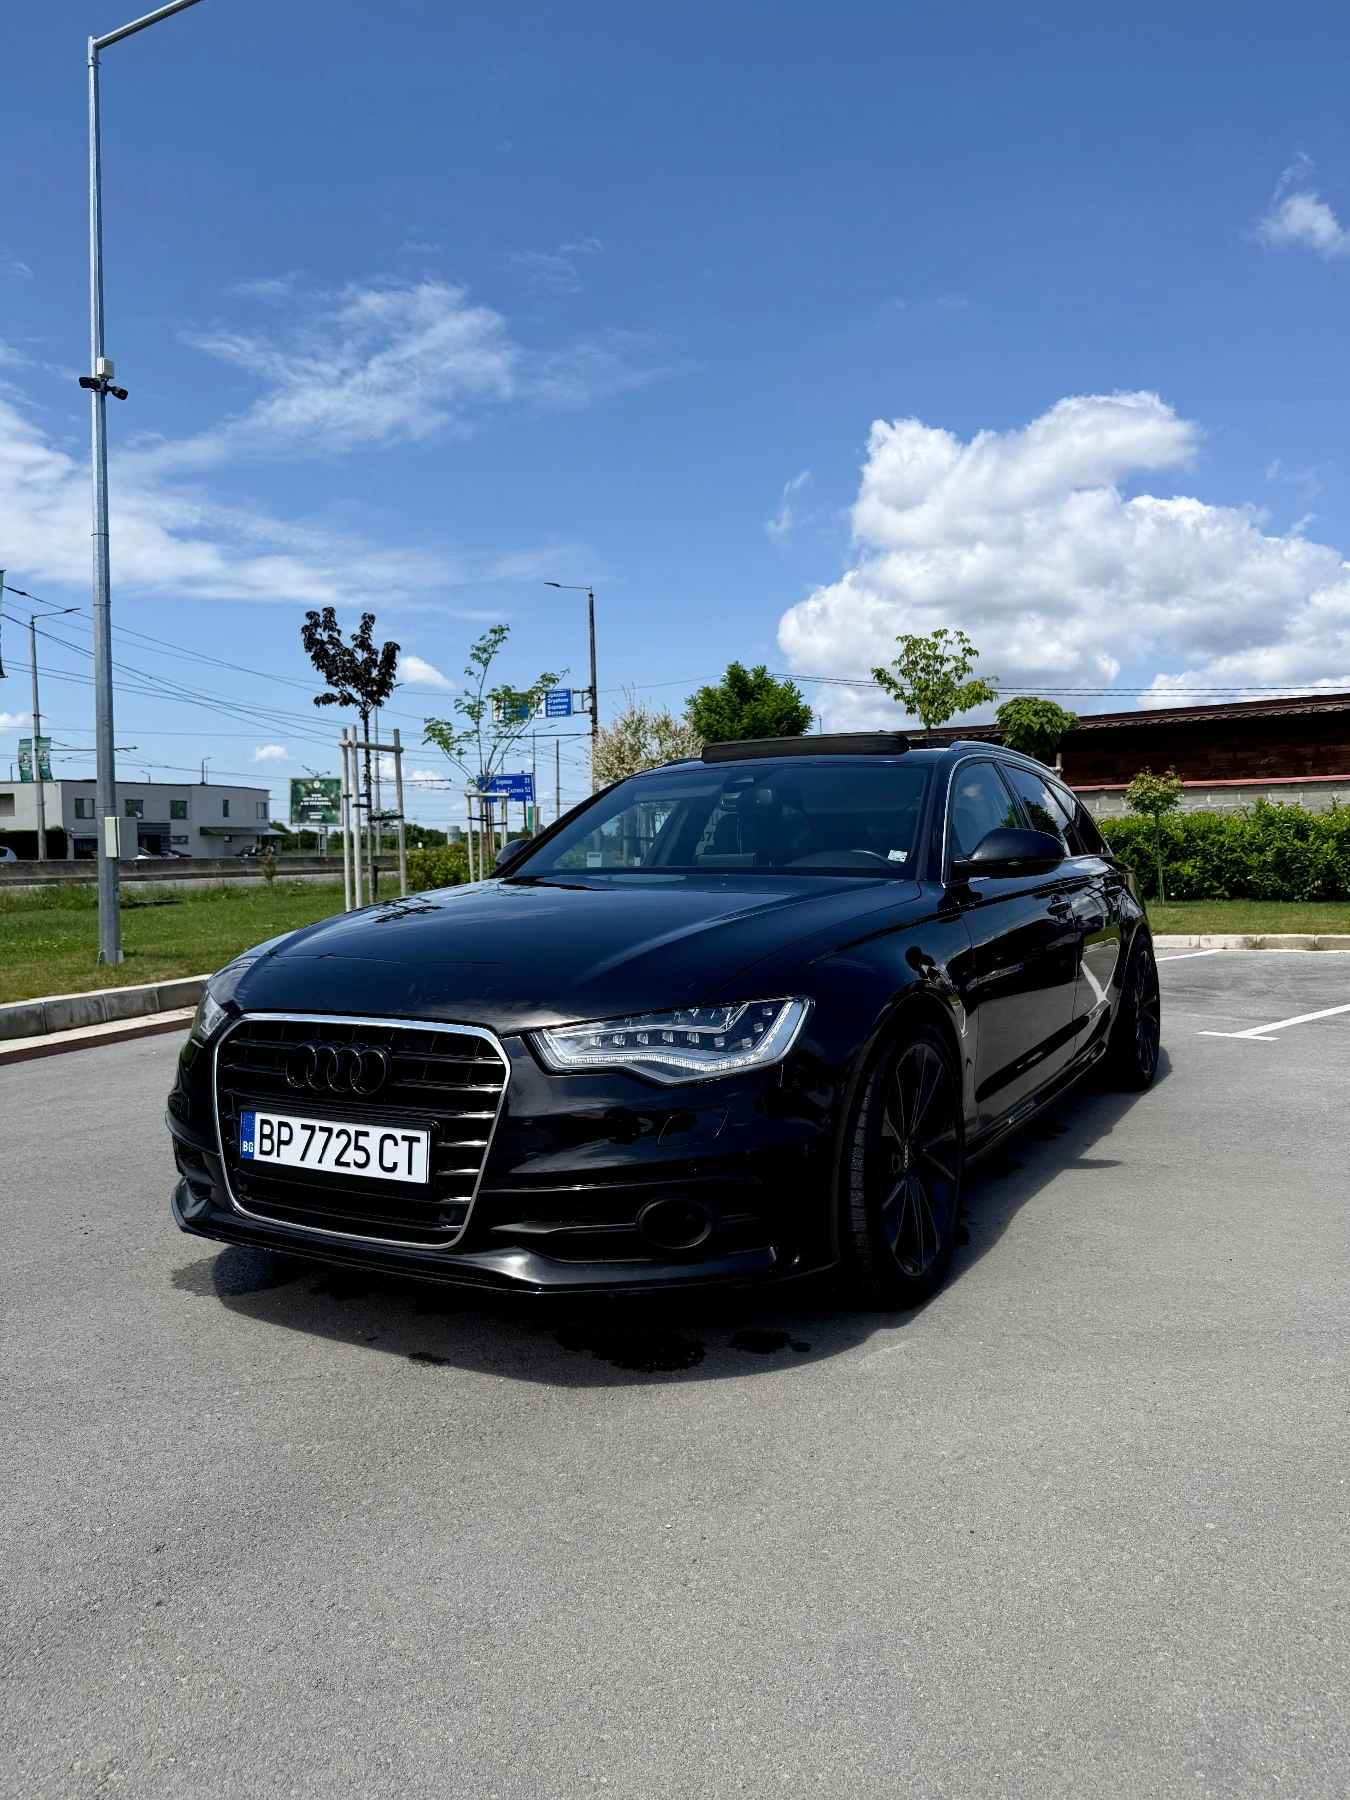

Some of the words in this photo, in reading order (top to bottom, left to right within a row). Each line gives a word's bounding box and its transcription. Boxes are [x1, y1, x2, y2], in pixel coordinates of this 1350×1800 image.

[242, 1140, 254, 1153] BG
[258, 1118, 294, 1158] BP
[300, 1123, 371, 1169] 7725
[378, 1133, 421, 1176] CT
